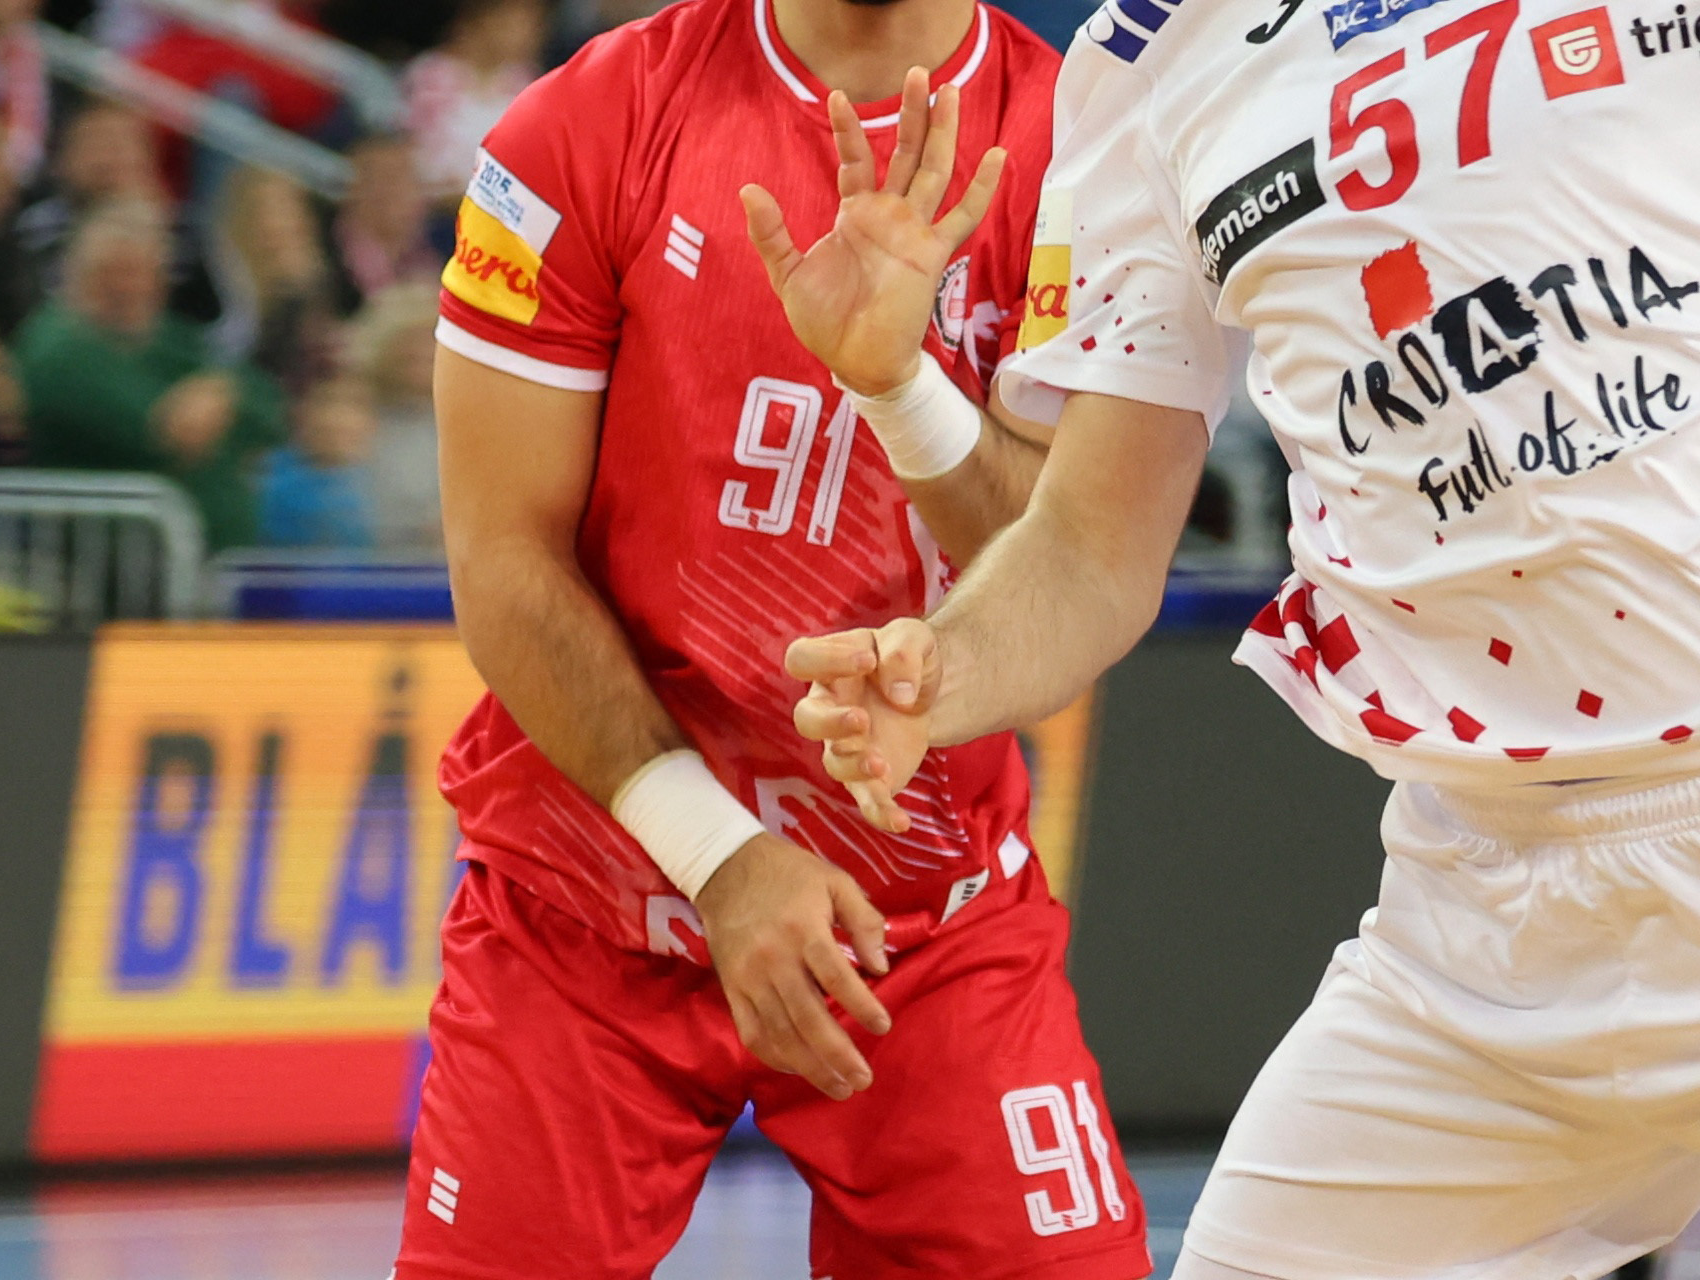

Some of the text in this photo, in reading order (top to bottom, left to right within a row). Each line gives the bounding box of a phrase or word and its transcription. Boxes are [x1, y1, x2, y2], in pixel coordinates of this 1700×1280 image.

[1331, 1, 1369, 41] AC
[1337, 245, 1700, 457] CROATIA
[717, 375, 860, 547] 91
[1417, 423, 1512, 522] Full
[1515, 390, 1578, 476] of
[1000, 1079, 1127, 1238] 91
